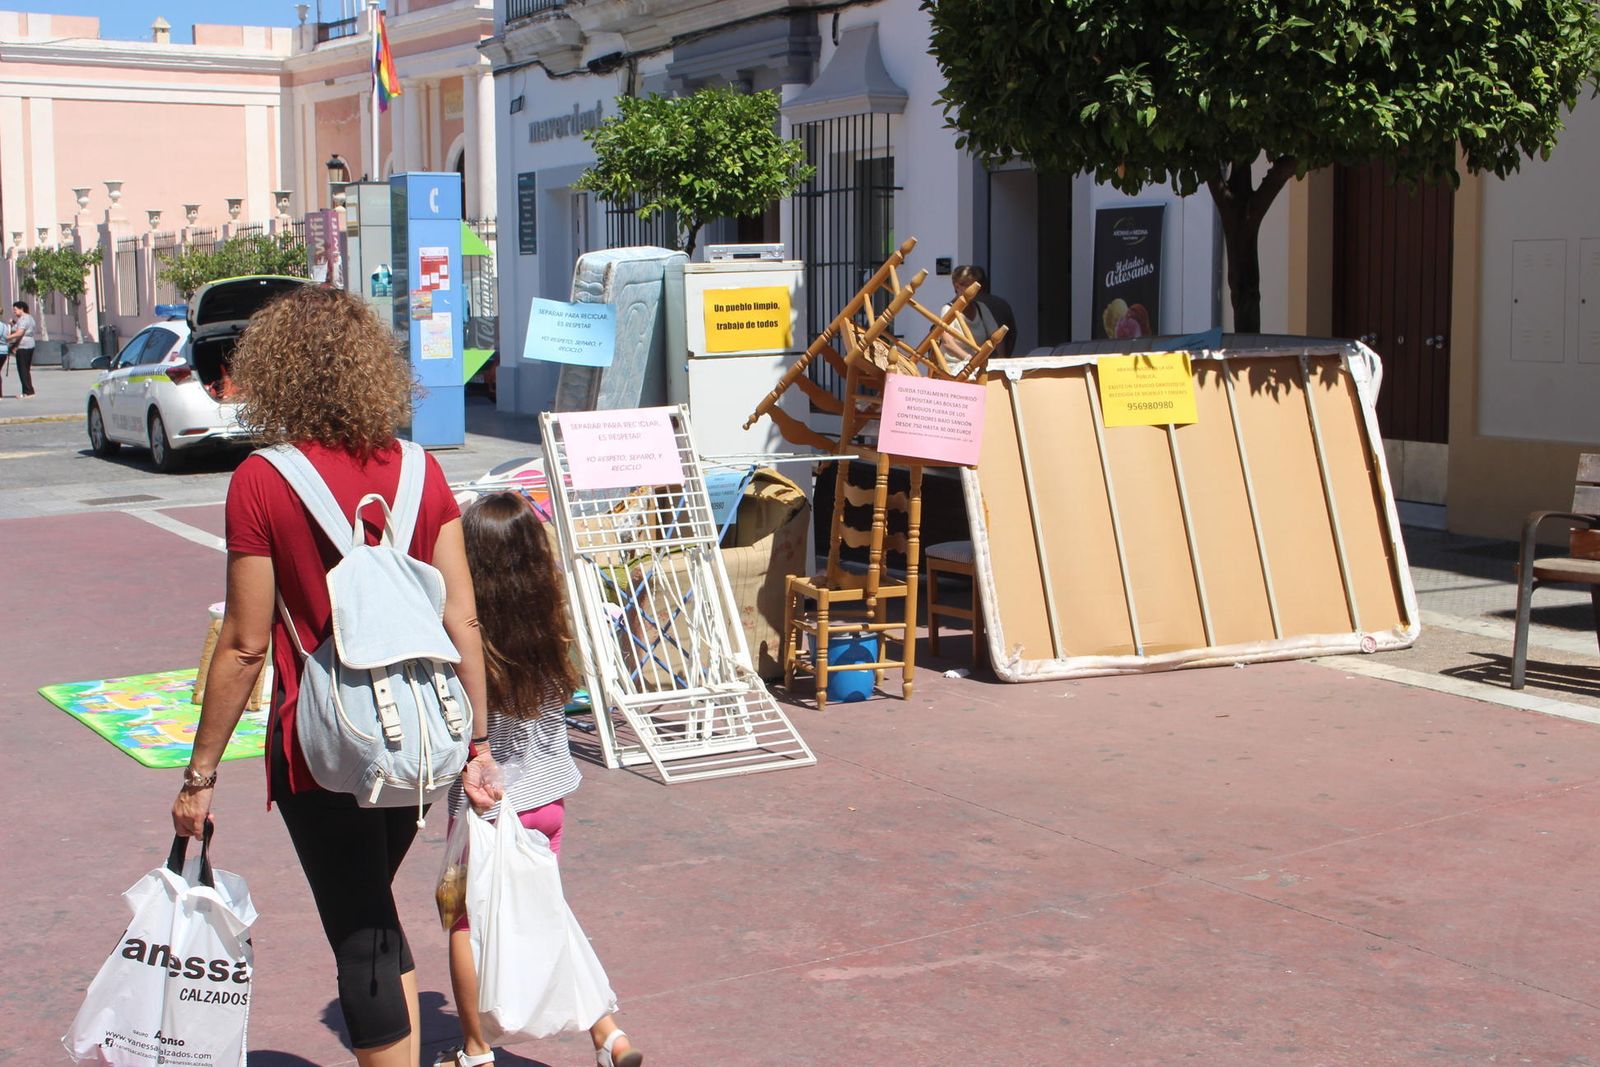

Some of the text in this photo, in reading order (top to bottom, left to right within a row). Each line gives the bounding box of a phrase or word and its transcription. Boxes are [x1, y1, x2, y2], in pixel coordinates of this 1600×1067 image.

[1115, 256, 1144, 273] Helados
[1106, 263, 1154, 288] Artesanos
[538, 308, 563, 317] SEPARAR
[714, 304, 724, 312] Un
[725, 303, 752, 312] pueblo
[716, 322, 744, 330] trabajo
[757, 320, 778, 328] todos
[917, 389, 949, 398] TOTALMENTE
[905, 396, 932, 404] DEPOSITAR
[1127, 401, 1174, 411] 956980980
[897, 412, 937, 422] CONTENEDORES
[110, 929, 250, 984] anessa
[180, 988, 248, 1005] CALZADOS
[105, 1030, 212, 1060] www.vanessaalzados.com
